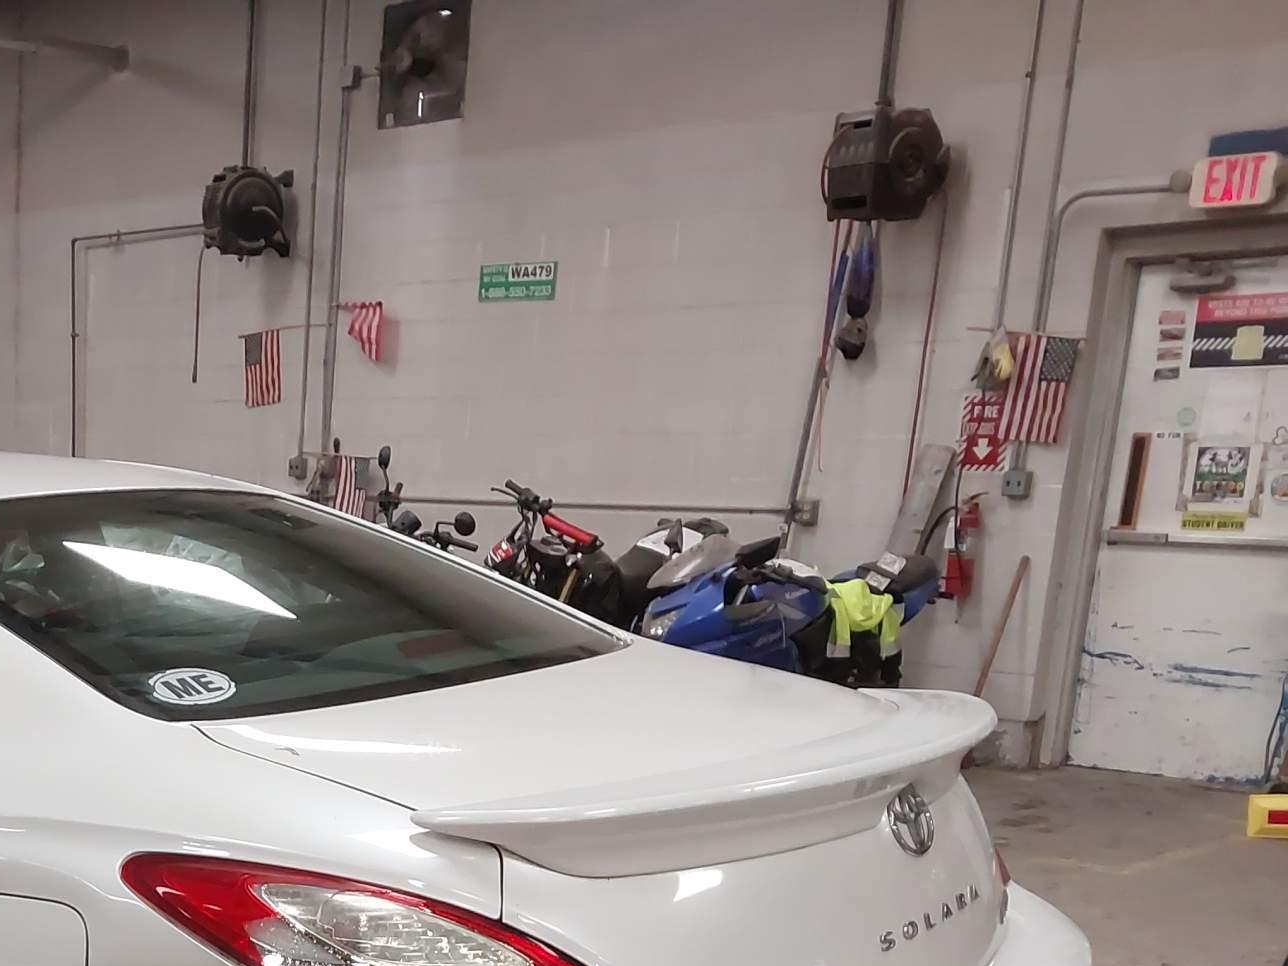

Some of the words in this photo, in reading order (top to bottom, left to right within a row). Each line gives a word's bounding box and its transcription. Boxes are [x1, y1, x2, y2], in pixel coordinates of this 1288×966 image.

[1203, 155, 1266, 203] EXIT
[512, 265, 552, 279] WA479
[159, 674, 226, 699] ME
[879, 884, 980, 952] SOLARA
